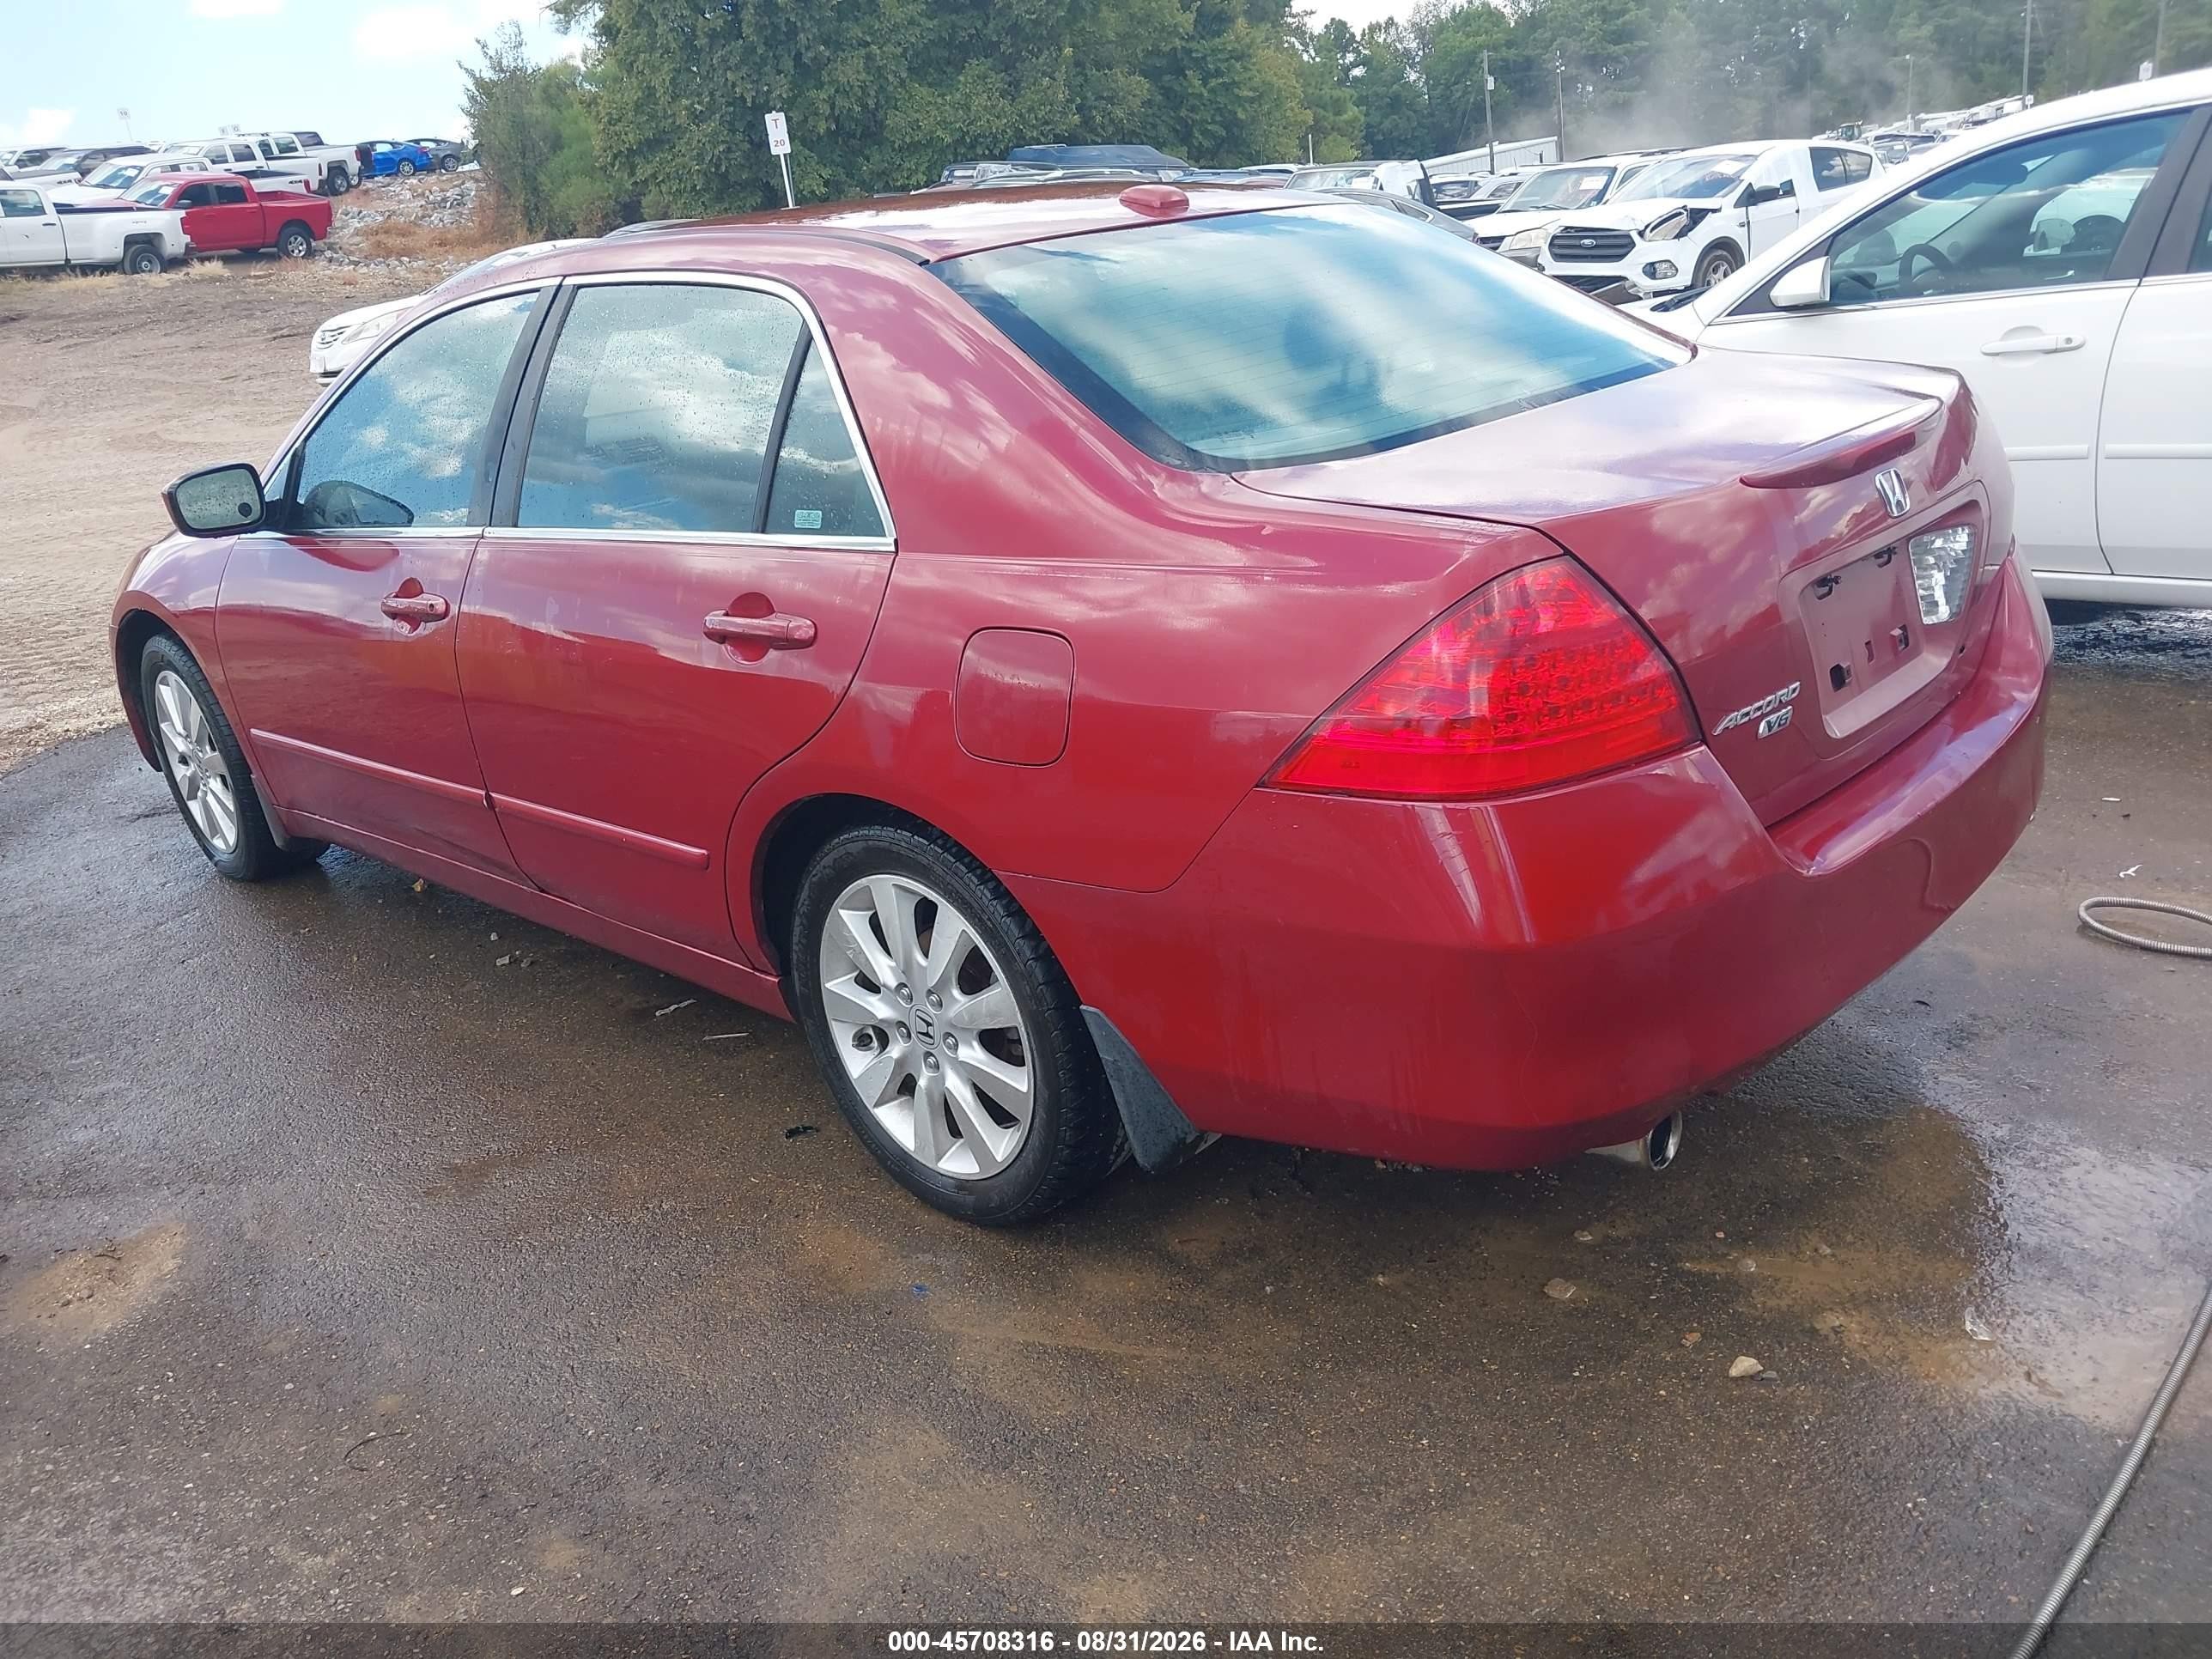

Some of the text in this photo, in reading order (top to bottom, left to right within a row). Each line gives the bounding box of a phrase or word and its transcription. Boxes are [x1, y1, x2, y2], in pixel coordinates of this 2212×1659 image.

[771, 118, 780, 130] T
[773, 138, 786, 148] 20
[1711, 681, 1801, 736] ACCORD
[1763, 711, 1790, 734] V6
